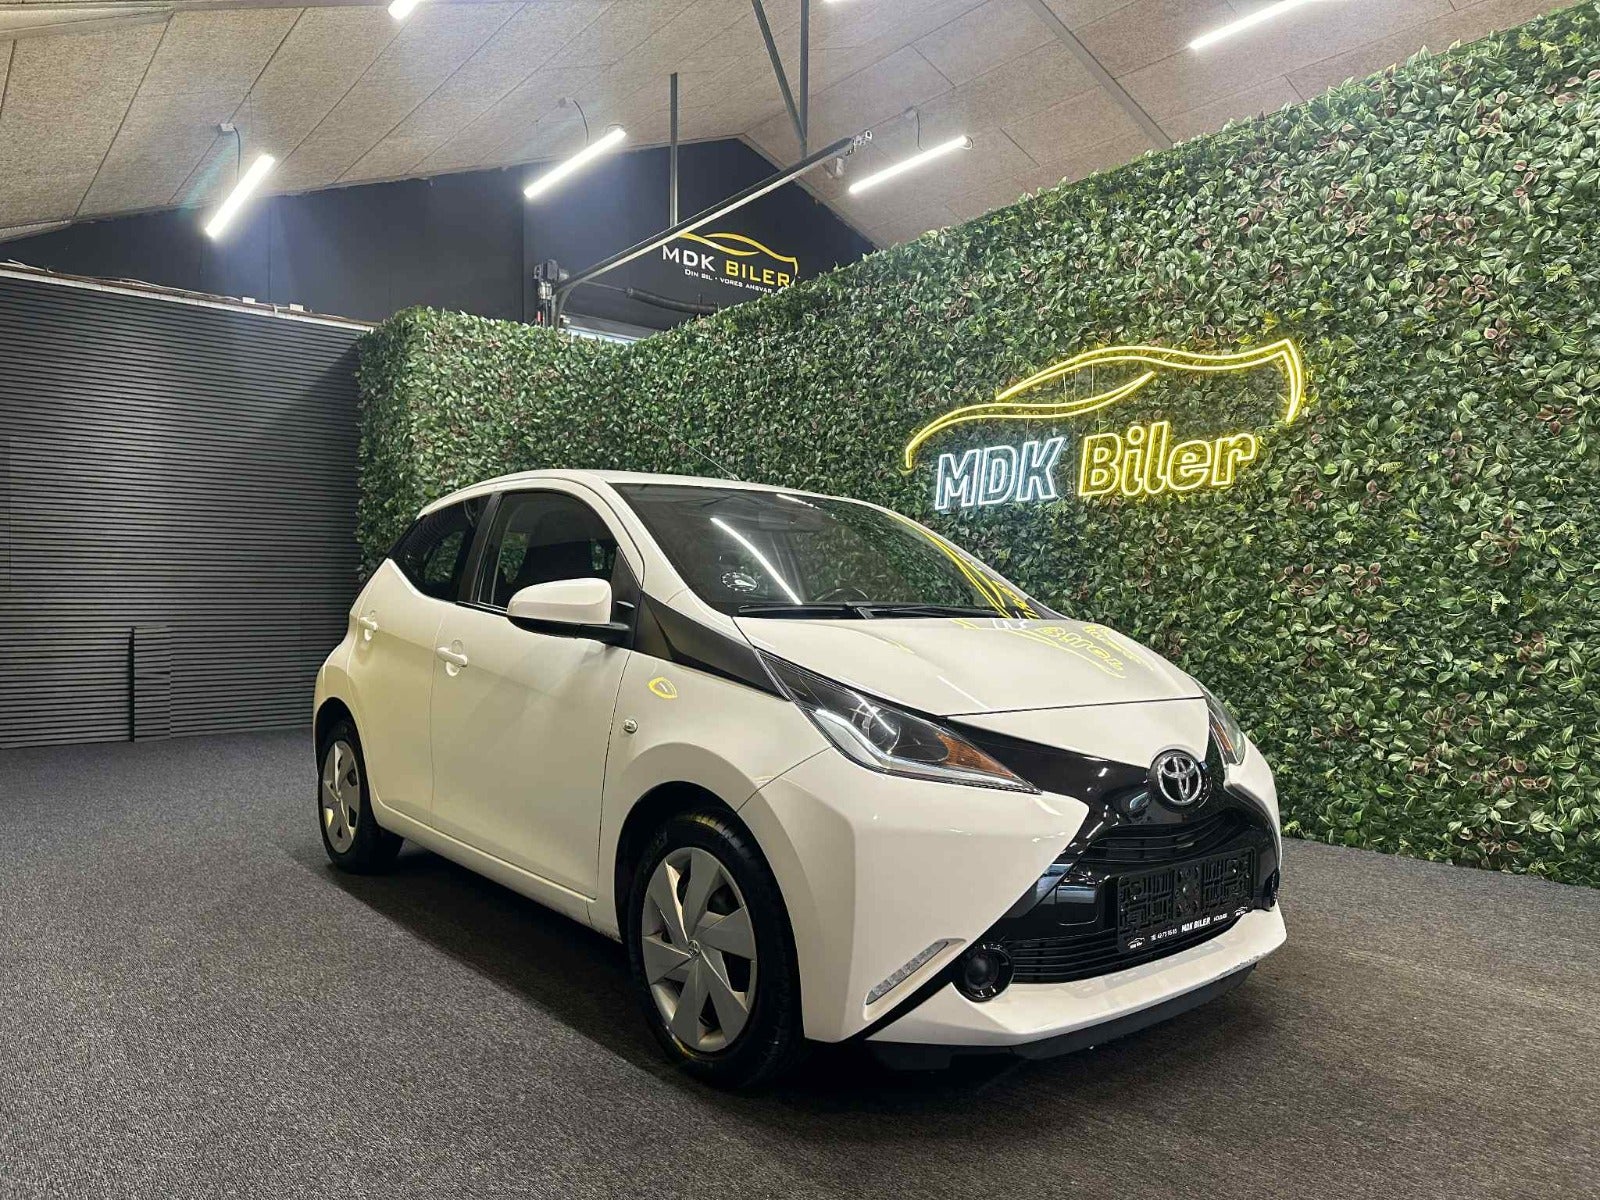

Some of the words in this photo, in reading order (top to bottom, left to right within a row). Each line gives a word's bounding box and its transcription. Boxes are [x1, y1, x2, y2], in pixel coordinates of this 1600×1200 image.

[662, 244, 716, 272] MDK
[725, 259, 790, 287] BILER
[719, 276, 743, 288] VORES
[934, 435, 1067, 511] MDK
[1078, 420, 1257, 497] Biler
[1193, 916, 1211, 929] BILER
